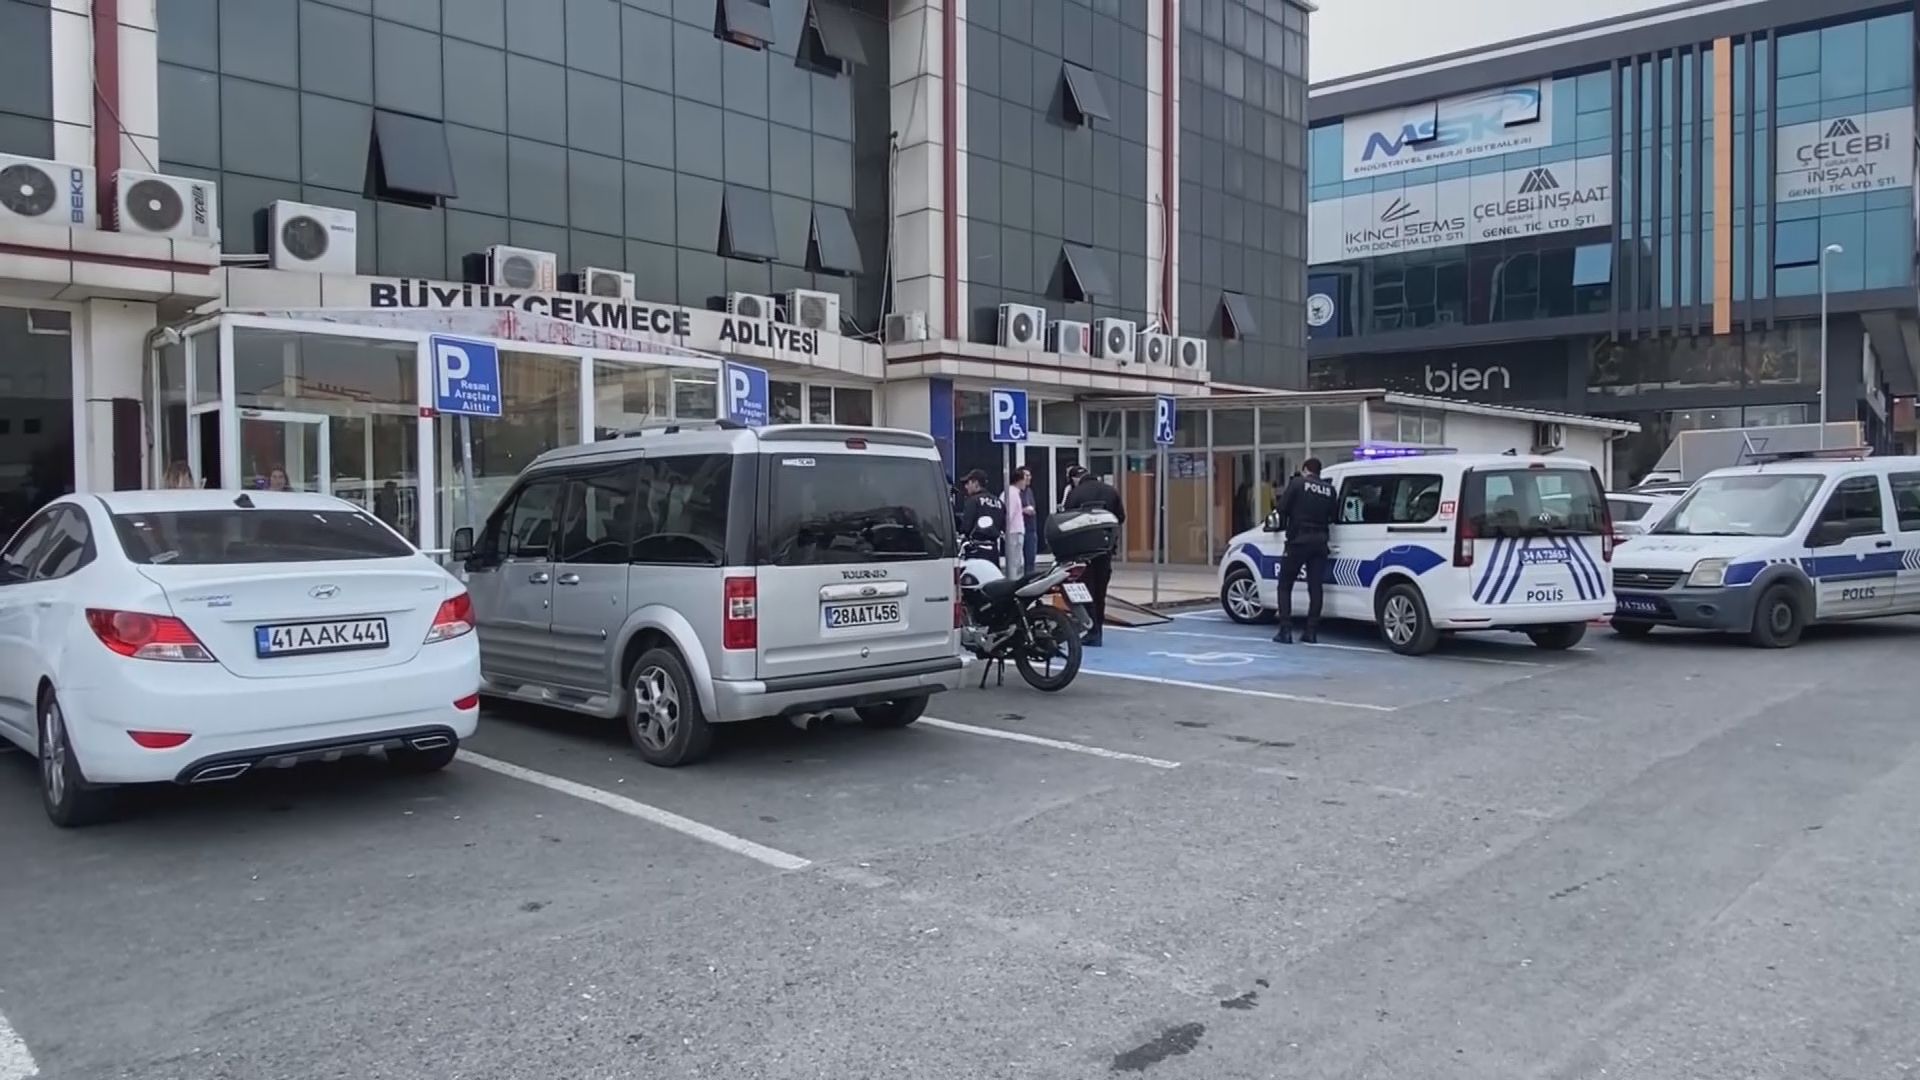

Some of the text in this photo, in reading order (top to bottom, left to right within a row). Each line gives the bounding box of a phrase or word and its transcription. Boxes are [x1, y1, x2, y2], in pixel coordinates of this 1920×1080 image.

[71, 168, 84, 223] BEKO
[1788, 187, 1824, 198] GENEL
[1404, 217, 1466, 236] SEMS
[1482, 225, 1520, 238] GENEL
[718, 317, 819, 356] ADLİYESİ
[437, 344, 470, 397] P
[461, 380, 490, 391] Resmi
[1425, 362, 1510, 393] bien
[454, 389, 497, 402] Araçlara
[730, 369, 750, 413] P
[993, 392, 1014, 435] P
[1157, 400, 1168, 437] P
